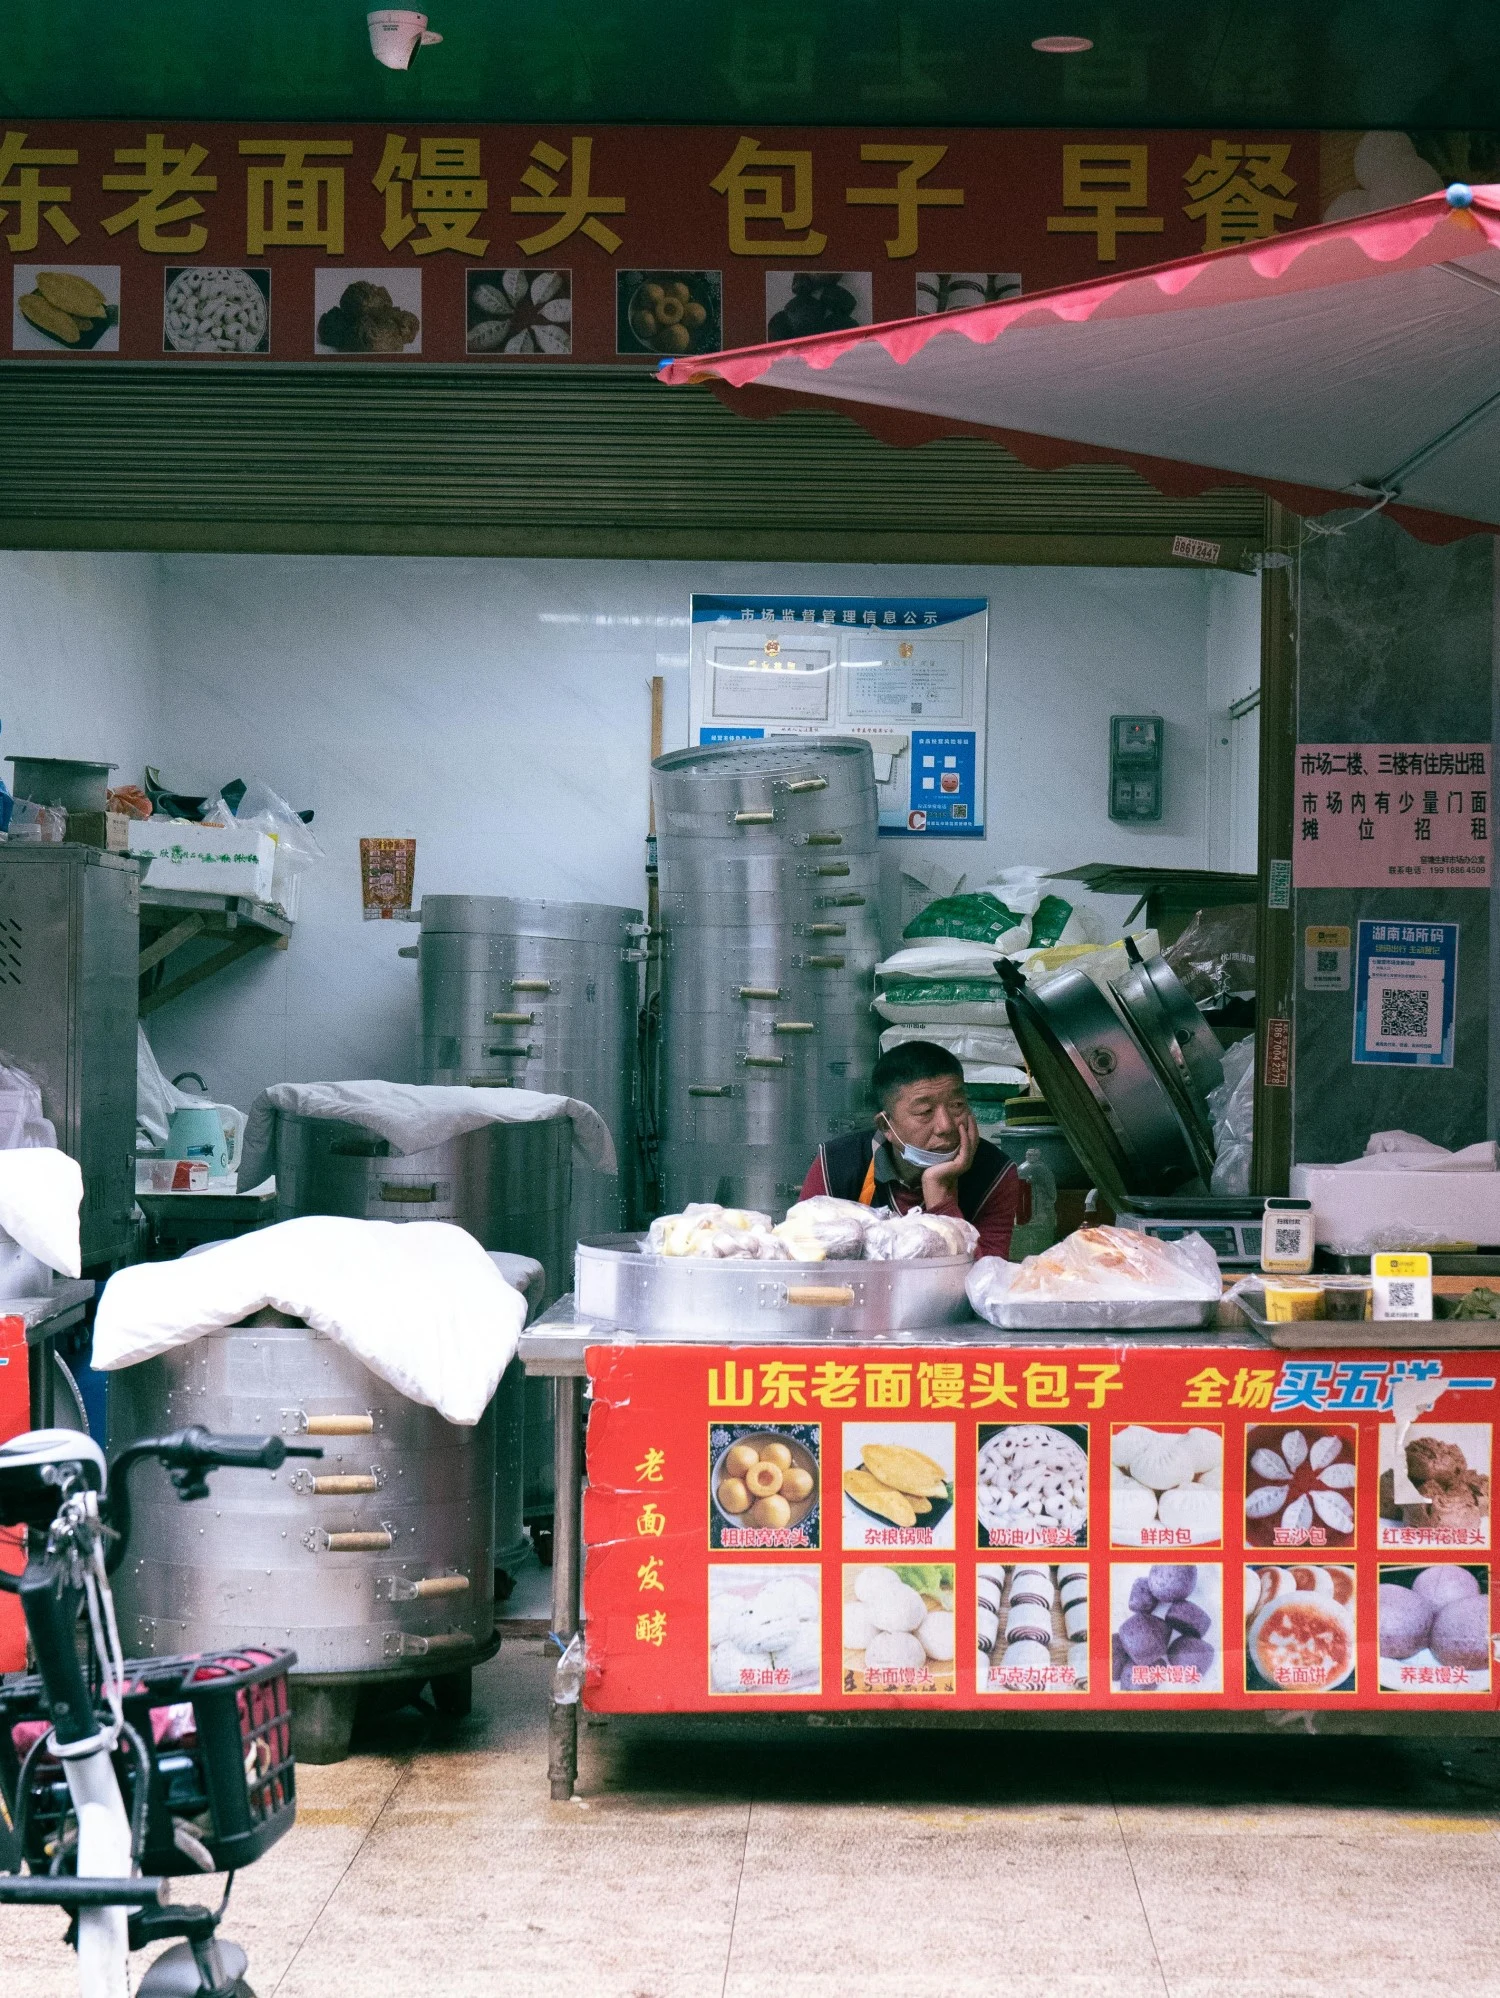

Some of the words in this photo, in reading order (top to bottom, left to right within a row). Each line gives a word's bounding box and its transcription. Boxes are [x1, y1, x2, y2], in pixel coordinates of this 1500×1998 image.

[709, 135, 965, 259] 包子
[1046, 139, 1299, 262] 早餐
[741, 608, 938, 625] 市场监督管理信息公示
[1300, 751, 1486, 777] 市场二楼、三楼有住房出租
[1301, 790, 1488, 815] 市场内有少量门面
[1301, 817, 1488, 841] 摊位招租
[1429, 866, 1444, 874] 199
[1372, 926, 1444, 943] 湖南场所码
[1273, 1023, 1283, 1038] 186
[1272, 1039, 1282, 1061] 7004
[1271, 1062, 1281, 1084] 2378
[708, 1361, 1124, 1410] 山东老面馒头包子
[721, 1527, 810, 1547] 粗粮窝窝头
[864, 1527, 934, 1546] 杂粮锅贴
[988, 1527, 1076, 1547] 奶油小馒头
[1140, 1527, 1192, 1546] 鲜肉包
[1273, 1527, 1327, 1546] 豆沙包
[1381, 1527, 1487, 1547] 红枣开花馒头
[634, 1446, 668, 1648] 老面发酵
[739, 1667, 791, 1687] 葱油卷
[864, 1666, 934, 1685] 老面馒头
[1131, 1666, 1202, 1686] 黑米馒头
[1275, 1667, 1327, 1686] 老面饼
[1400, 1666, 1470, 1686] 荞麦馒头
